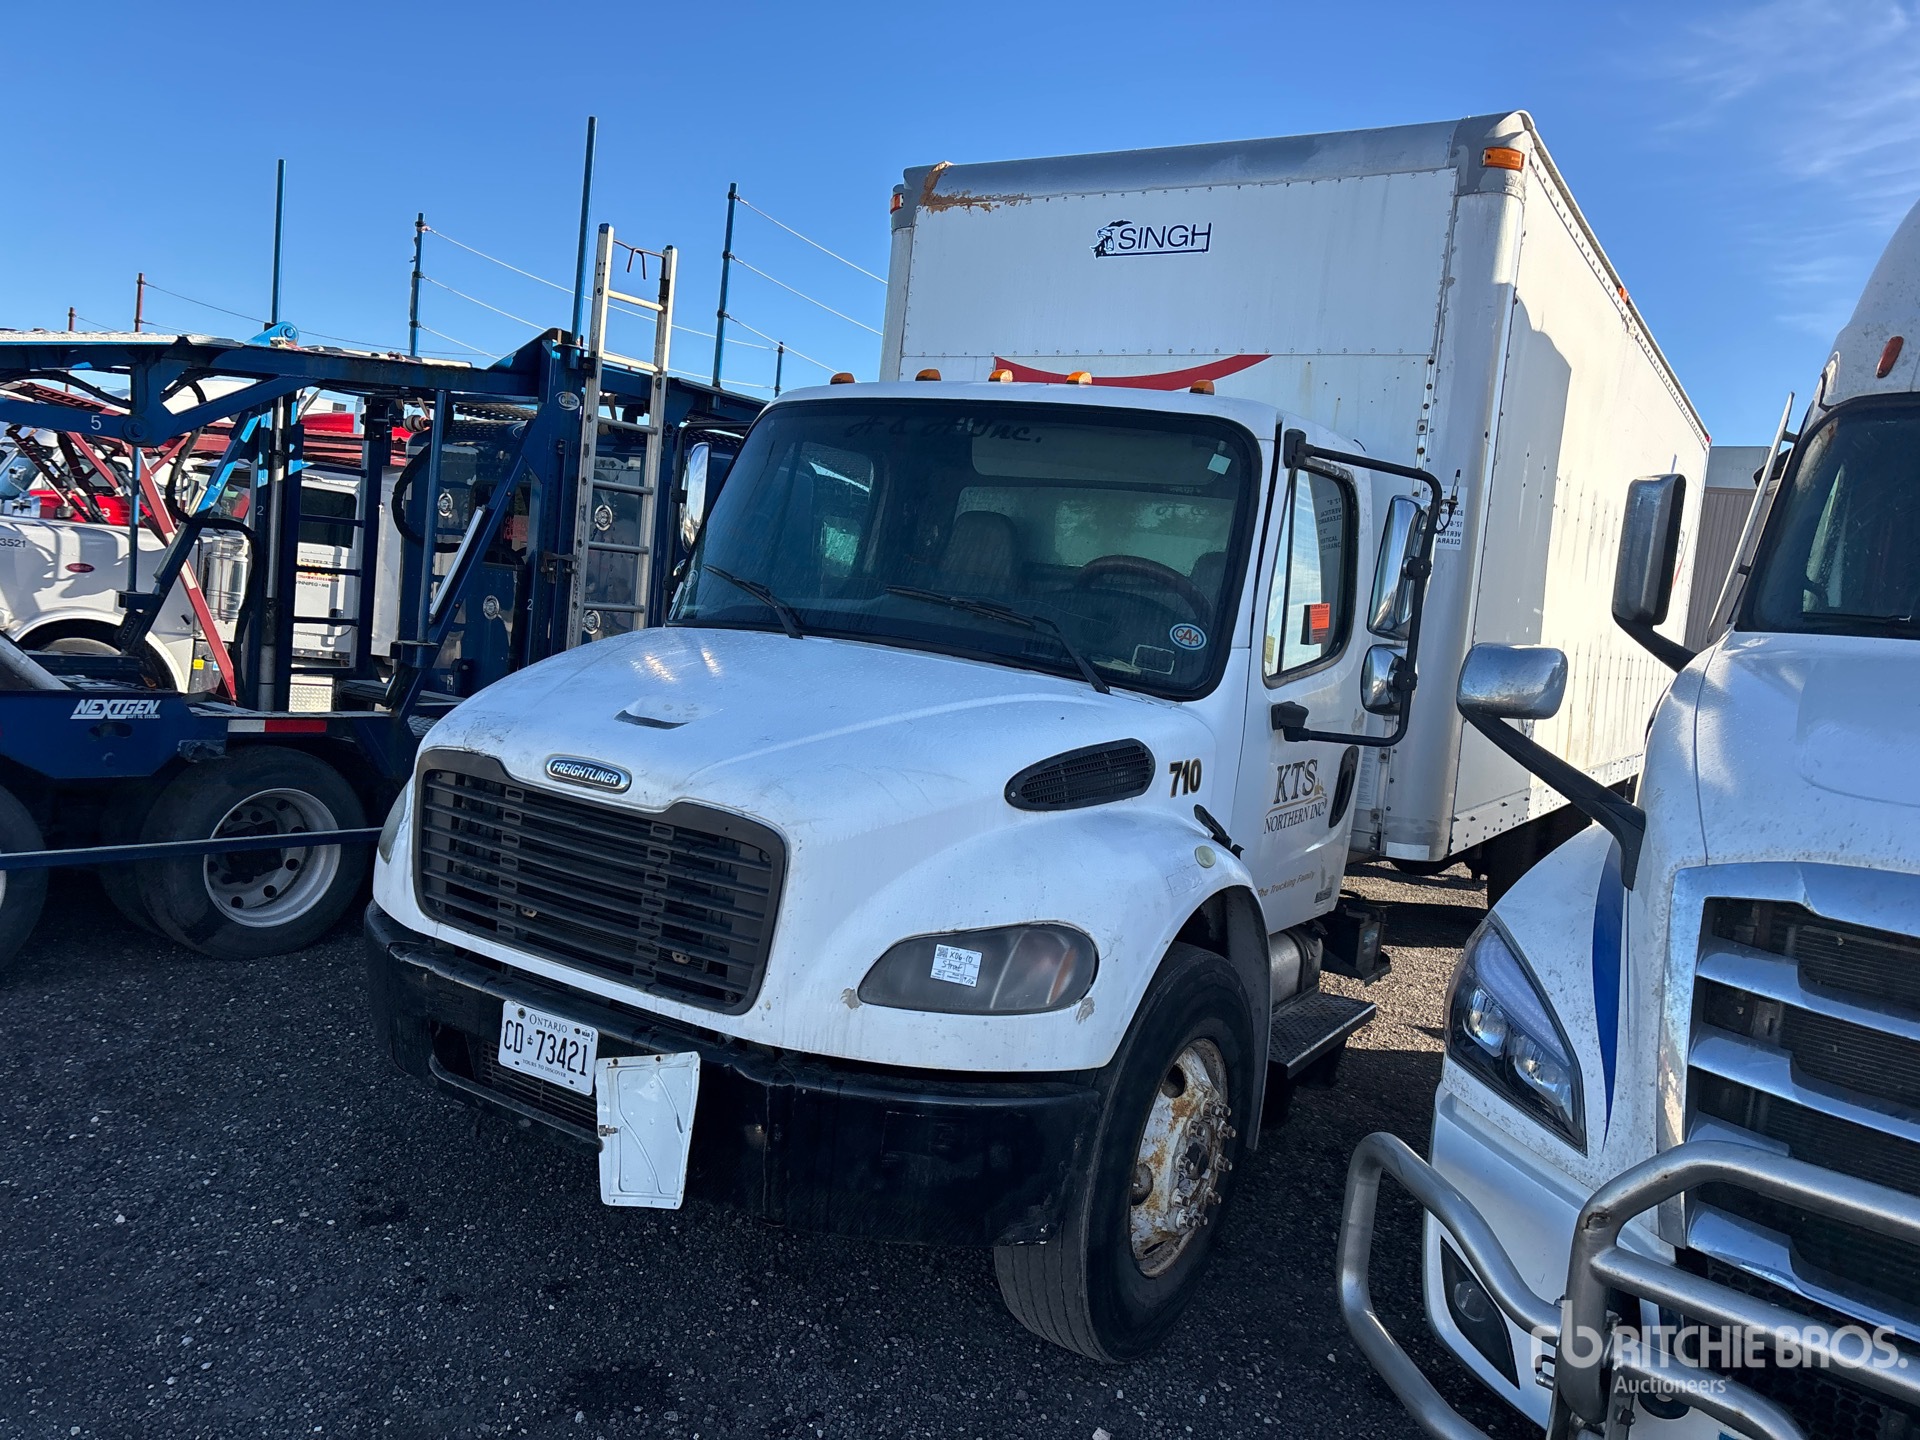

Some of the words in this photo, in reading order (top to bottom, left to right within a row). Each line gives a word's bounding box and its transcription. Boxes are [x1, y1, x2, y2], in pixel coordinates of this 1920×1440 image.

[1118, 222, 1212, 253] SINGH
[91, 415, 102, 431] 5
[257, 505, 265, 516] 2
[0, 538, 26, 548] 3521
[527, 599, 534, 611] 2
[1175, 628, 1200, 645] CAA
[70, 699, 162, 719] NEXTGEN
[552, 761, 619, 785] FREIGHTLINER
[1168, 757, 1203, 799] 710
[1273, 759, 1318, 805] KTS
[1263, 806, 1311, 835] NORTHERN
[1269, 876, 1297, 894] Trucking
[504, 1019, 524, 1054] CD
[535, 1029, 588, 1077] 73421
